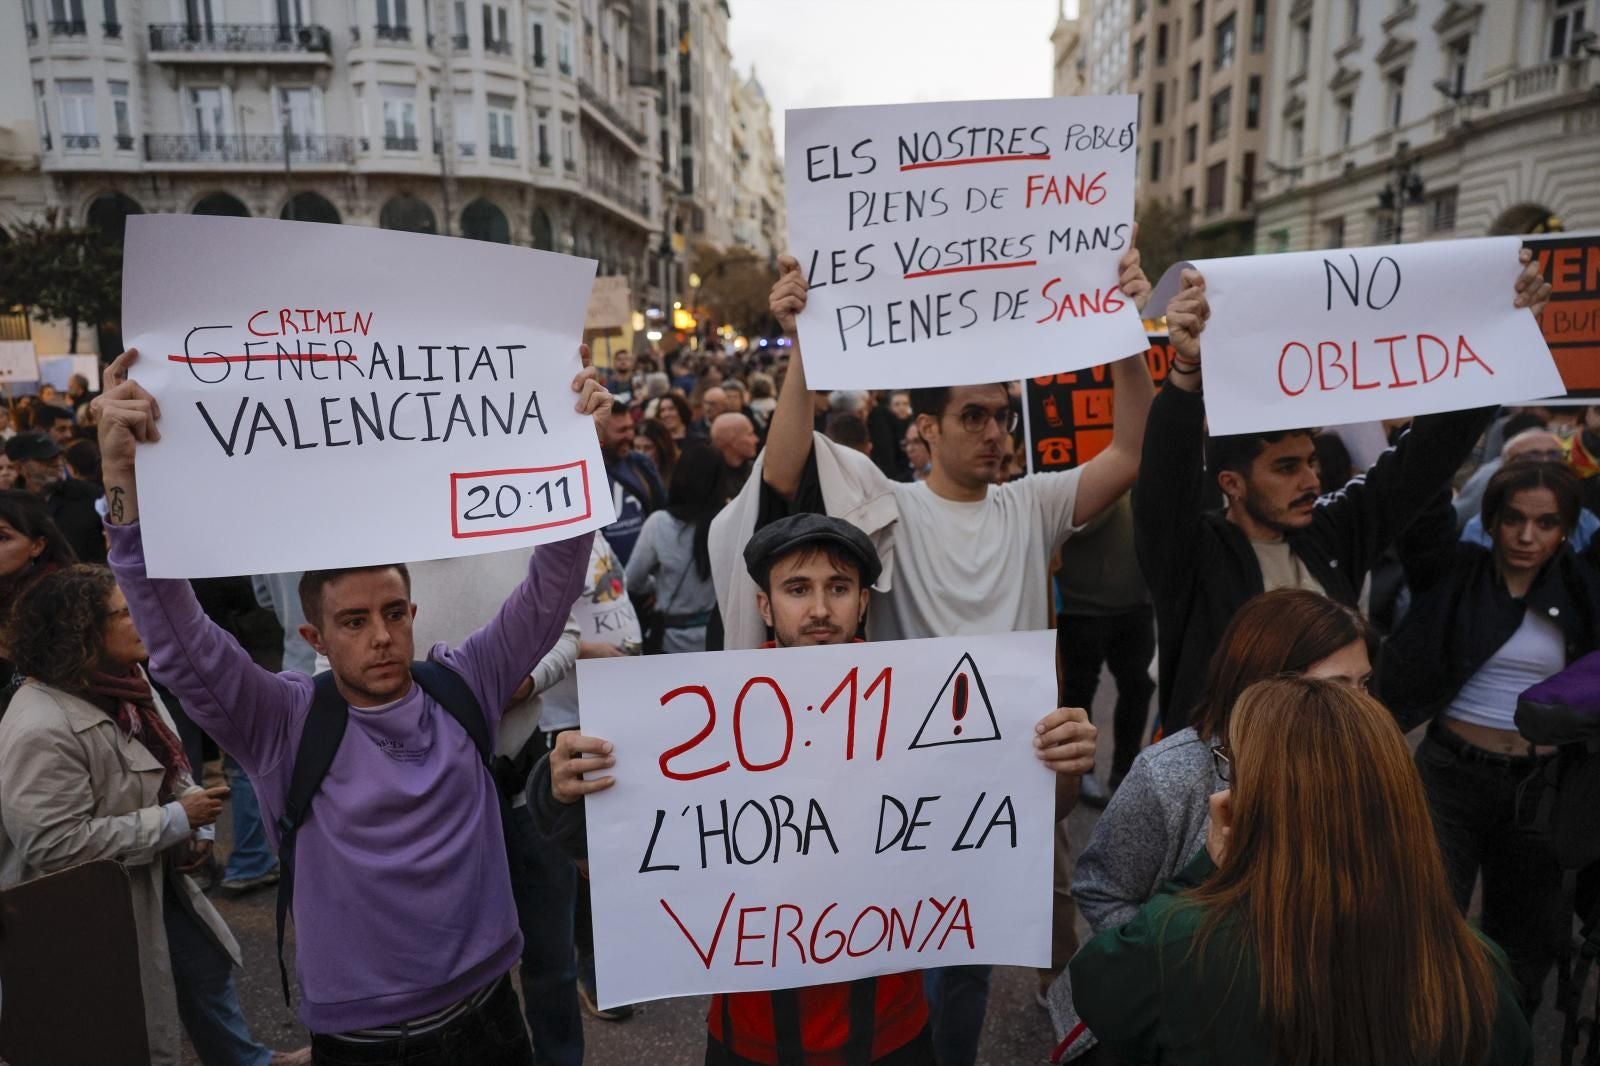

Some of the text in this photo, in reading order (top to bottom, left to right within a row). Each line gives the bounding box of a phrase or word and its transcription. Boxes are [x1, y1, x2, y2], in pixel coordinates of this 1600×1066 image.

[806, 121, 1136, 182] ELS NOSTRES POBLES
[849, 171, 1107, 231] PLENS DE FANG
[806, 223, 1129, 289] LES VOSTRES MANS
[1324, 253, 1401, 311] NO
[247, 308, 374, 337] CRIMIN
[836, 277, 1126, 352] PLENES DE SANG
[184, 324, 527, 384] GENERALITAT
[1277, 333, 1495, 397] OBLIDA
[195, 390, 548, 457] VALENCIANA
[463, 475, 572, 521] 20:11
[658, 666, 893, 782] 20:11
[638, 791, 1018, 874] L'HORA DE LA
[660, 892, 976, 970] VERGONYA
